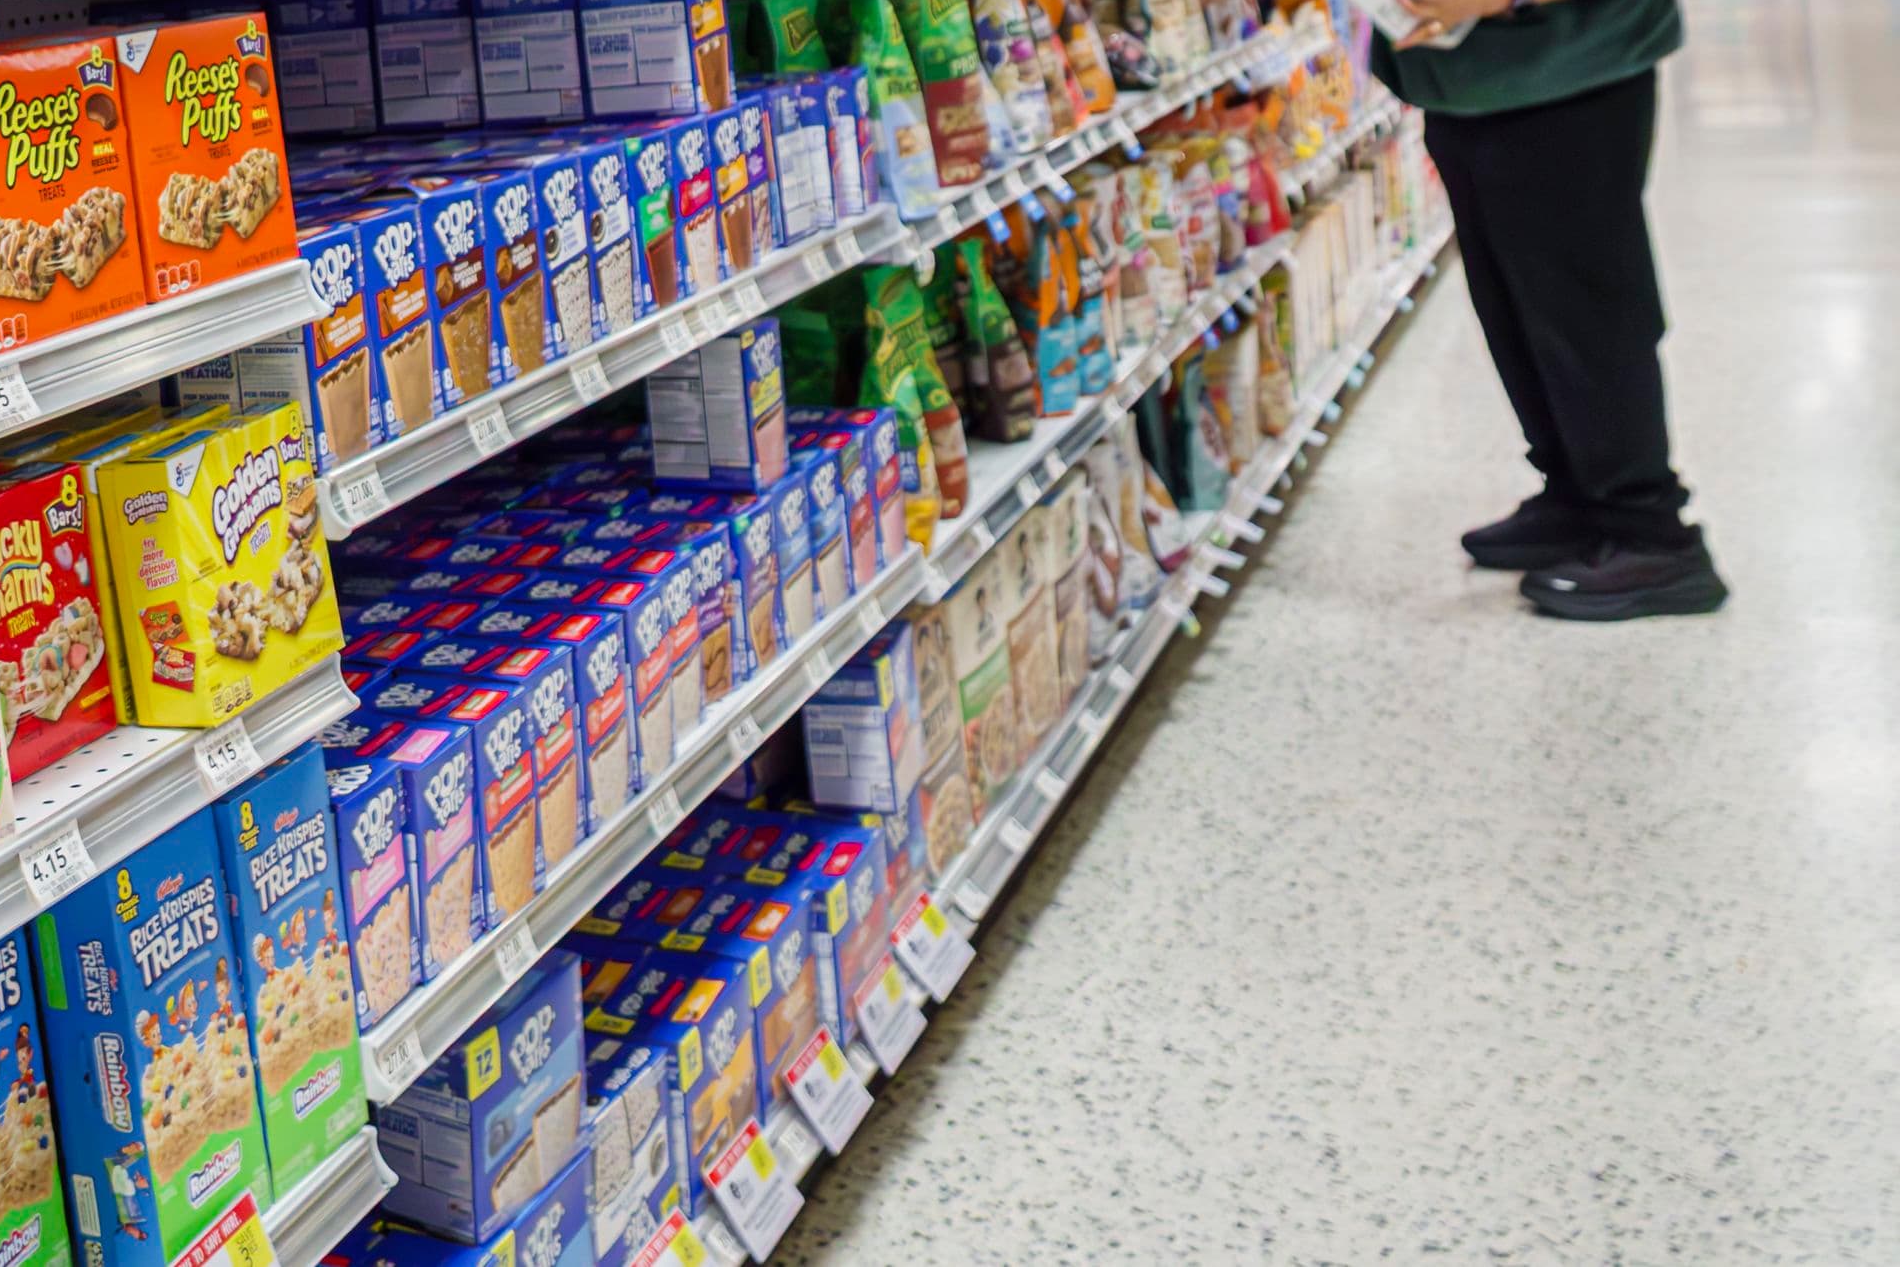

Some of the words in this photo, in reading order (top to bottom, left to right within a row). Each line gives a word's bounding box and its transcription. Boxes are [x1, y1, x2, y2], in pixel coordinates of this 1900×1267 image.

[181, 95, 241, 145] Puffs
[6, 131, 81, 188] Puffs
[61, 474, 78, 508] 8
[212, 446, 280, 534] Golden
[224, 478, 283, 566] Grahams
[205, 739, 238, 773] 4.15
[116, 868, 133, 902] 8
[256, 839, 330, 898] TREATS
[134, 913, 221, 987] TREATS
[357, 990, 368, 1015] 8
[474, 1046, 495, 1075] 12
